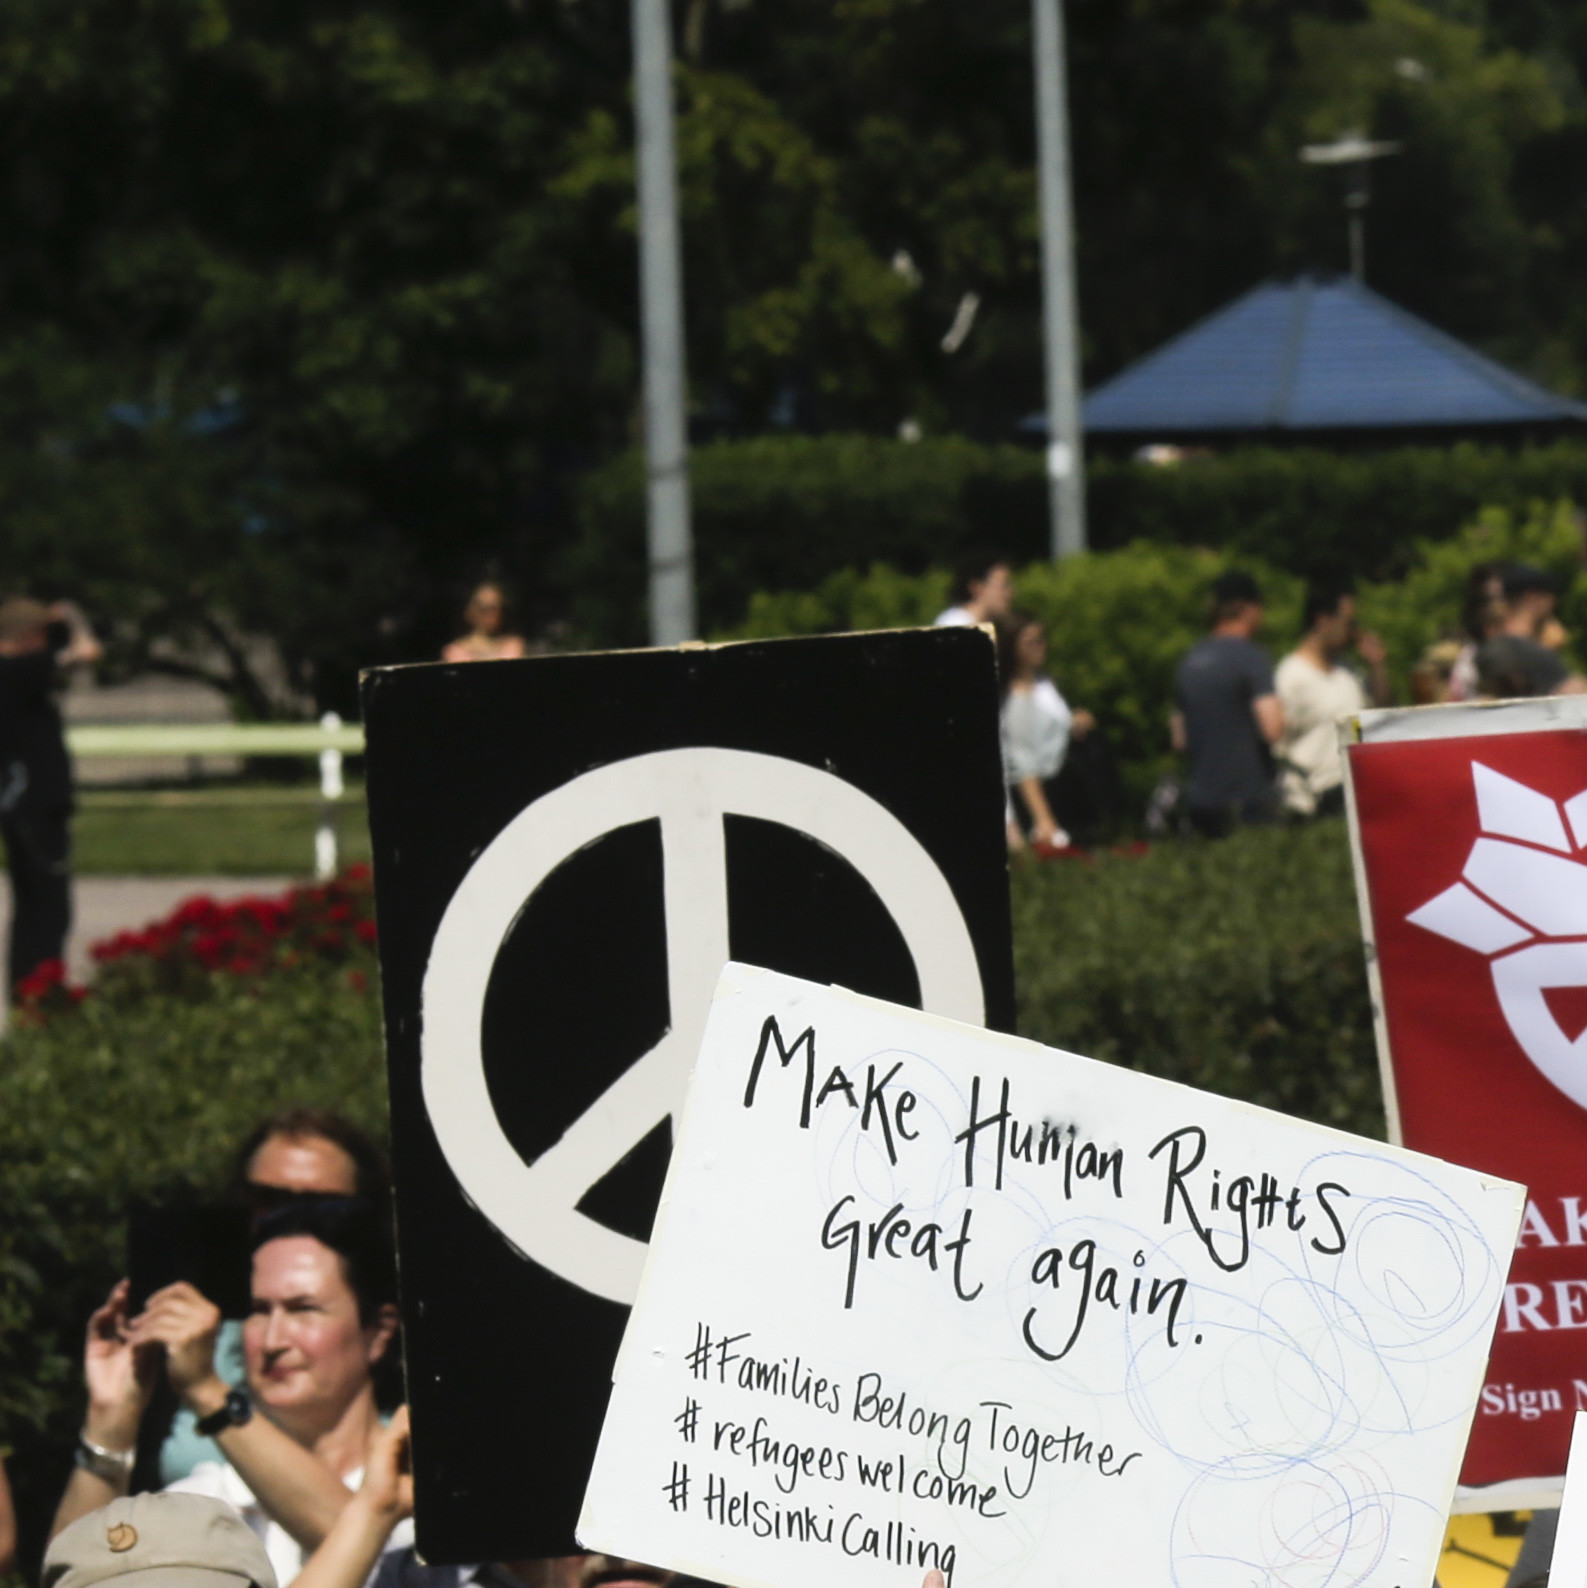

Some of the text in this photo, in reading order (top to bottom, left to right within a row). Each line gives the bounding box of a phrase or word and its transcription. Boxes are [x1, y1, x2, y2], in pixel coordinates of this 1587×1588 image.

[955, 1076, 1123, 1199] Human
[821, 1195, 1202, 1361] Great again.
[1482, 1382, 1561, 1420] Sign
